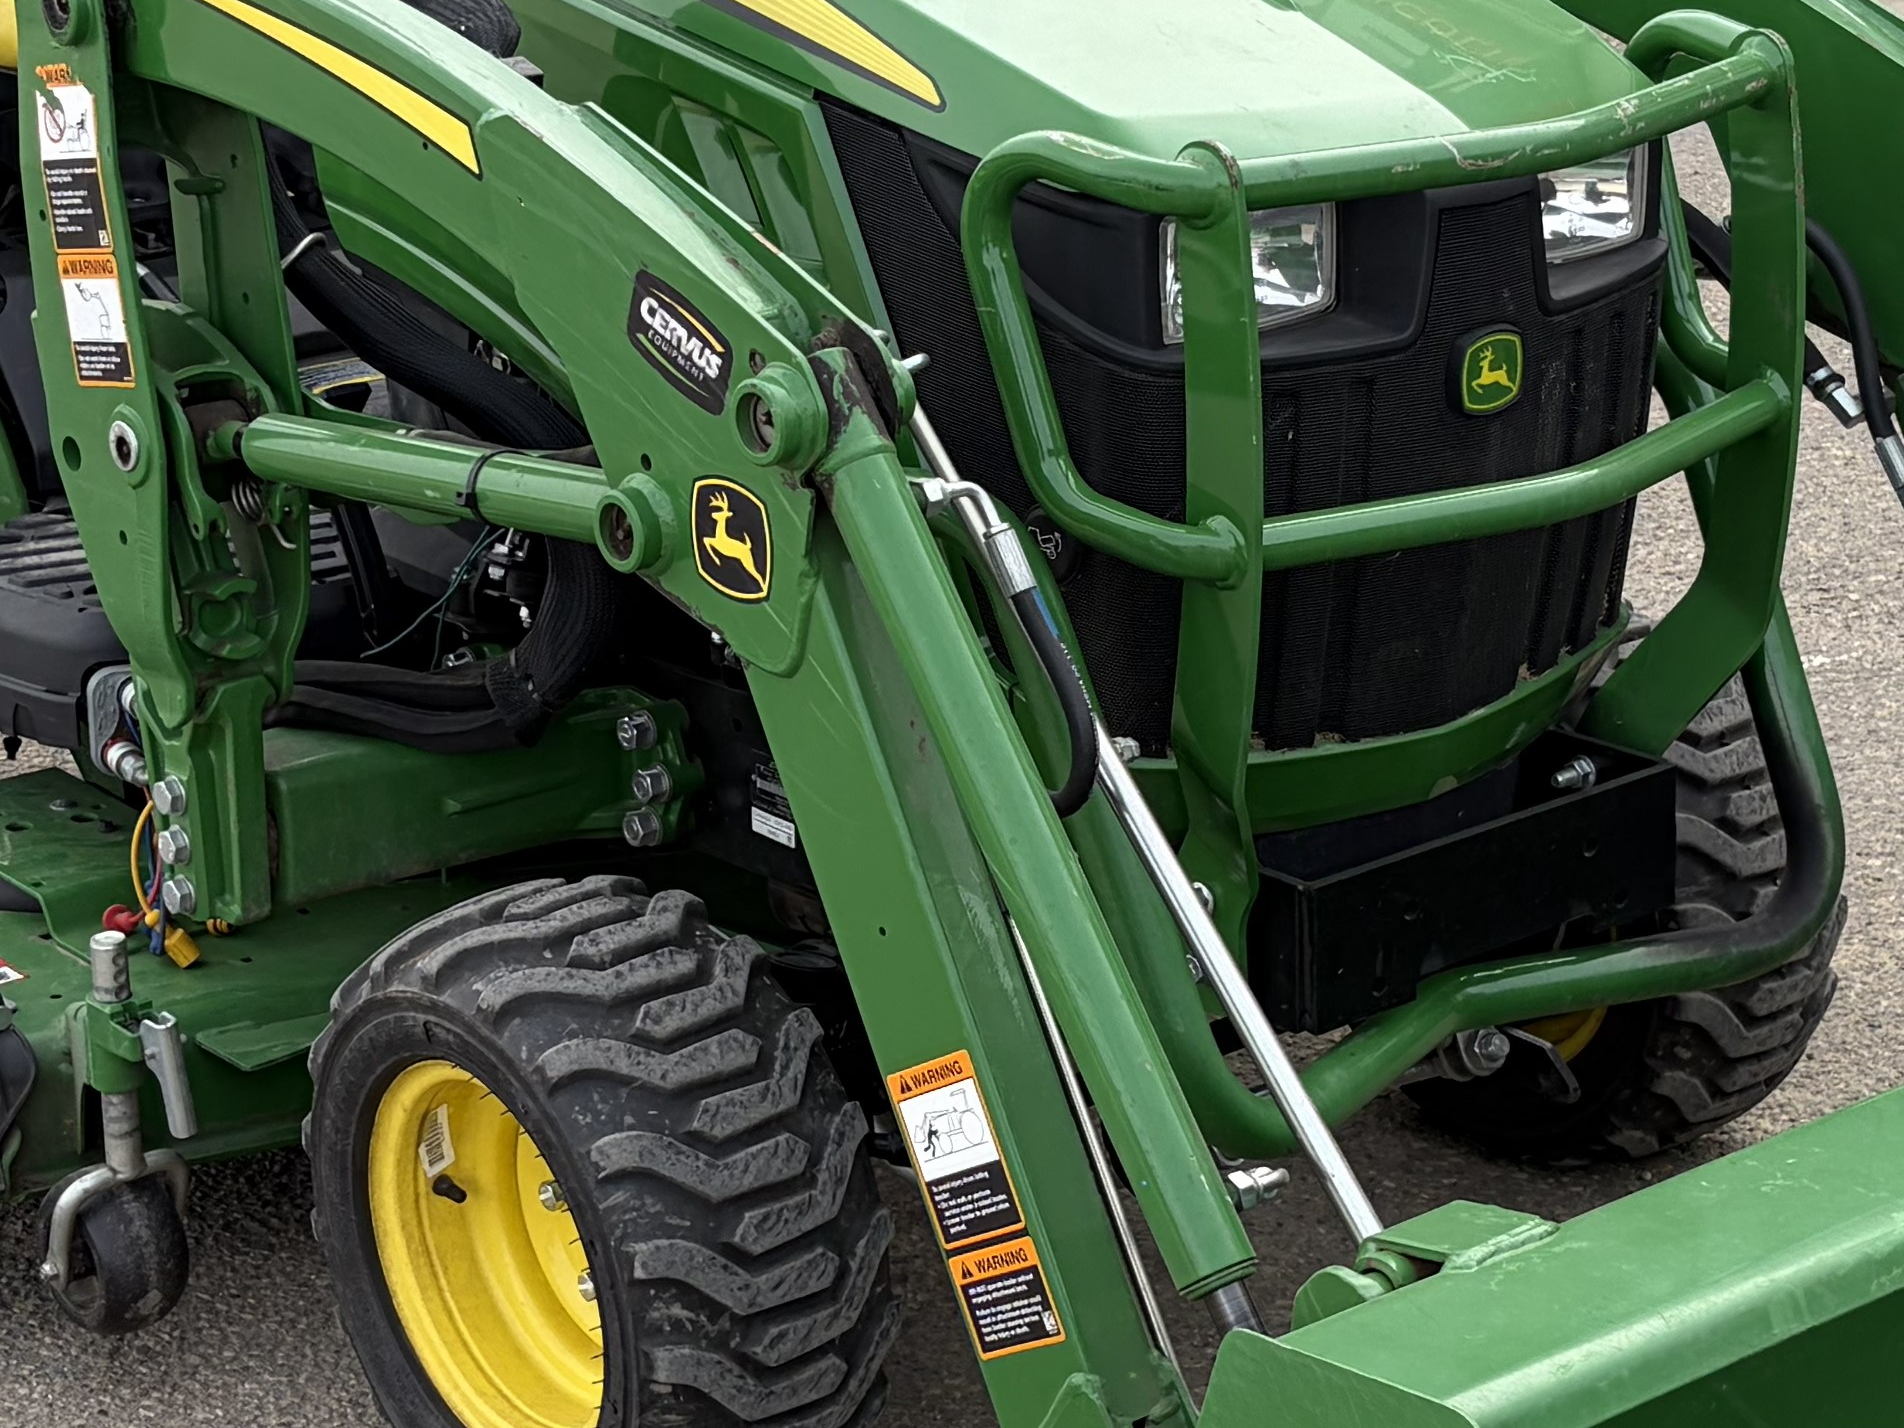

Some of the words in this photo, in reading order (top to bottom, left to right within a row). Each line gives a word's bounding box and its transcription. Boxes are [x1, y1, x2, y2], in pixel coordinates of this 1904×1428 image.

[69, 258, 115, 276] WARNING
[640, 297, 723, 379] CERVUS
[648, 329, 704, 382] EQUIPMENT
[910, 1060, 963, 1089] WARNING
[973, 1247, 1029, 1275] WARNING
